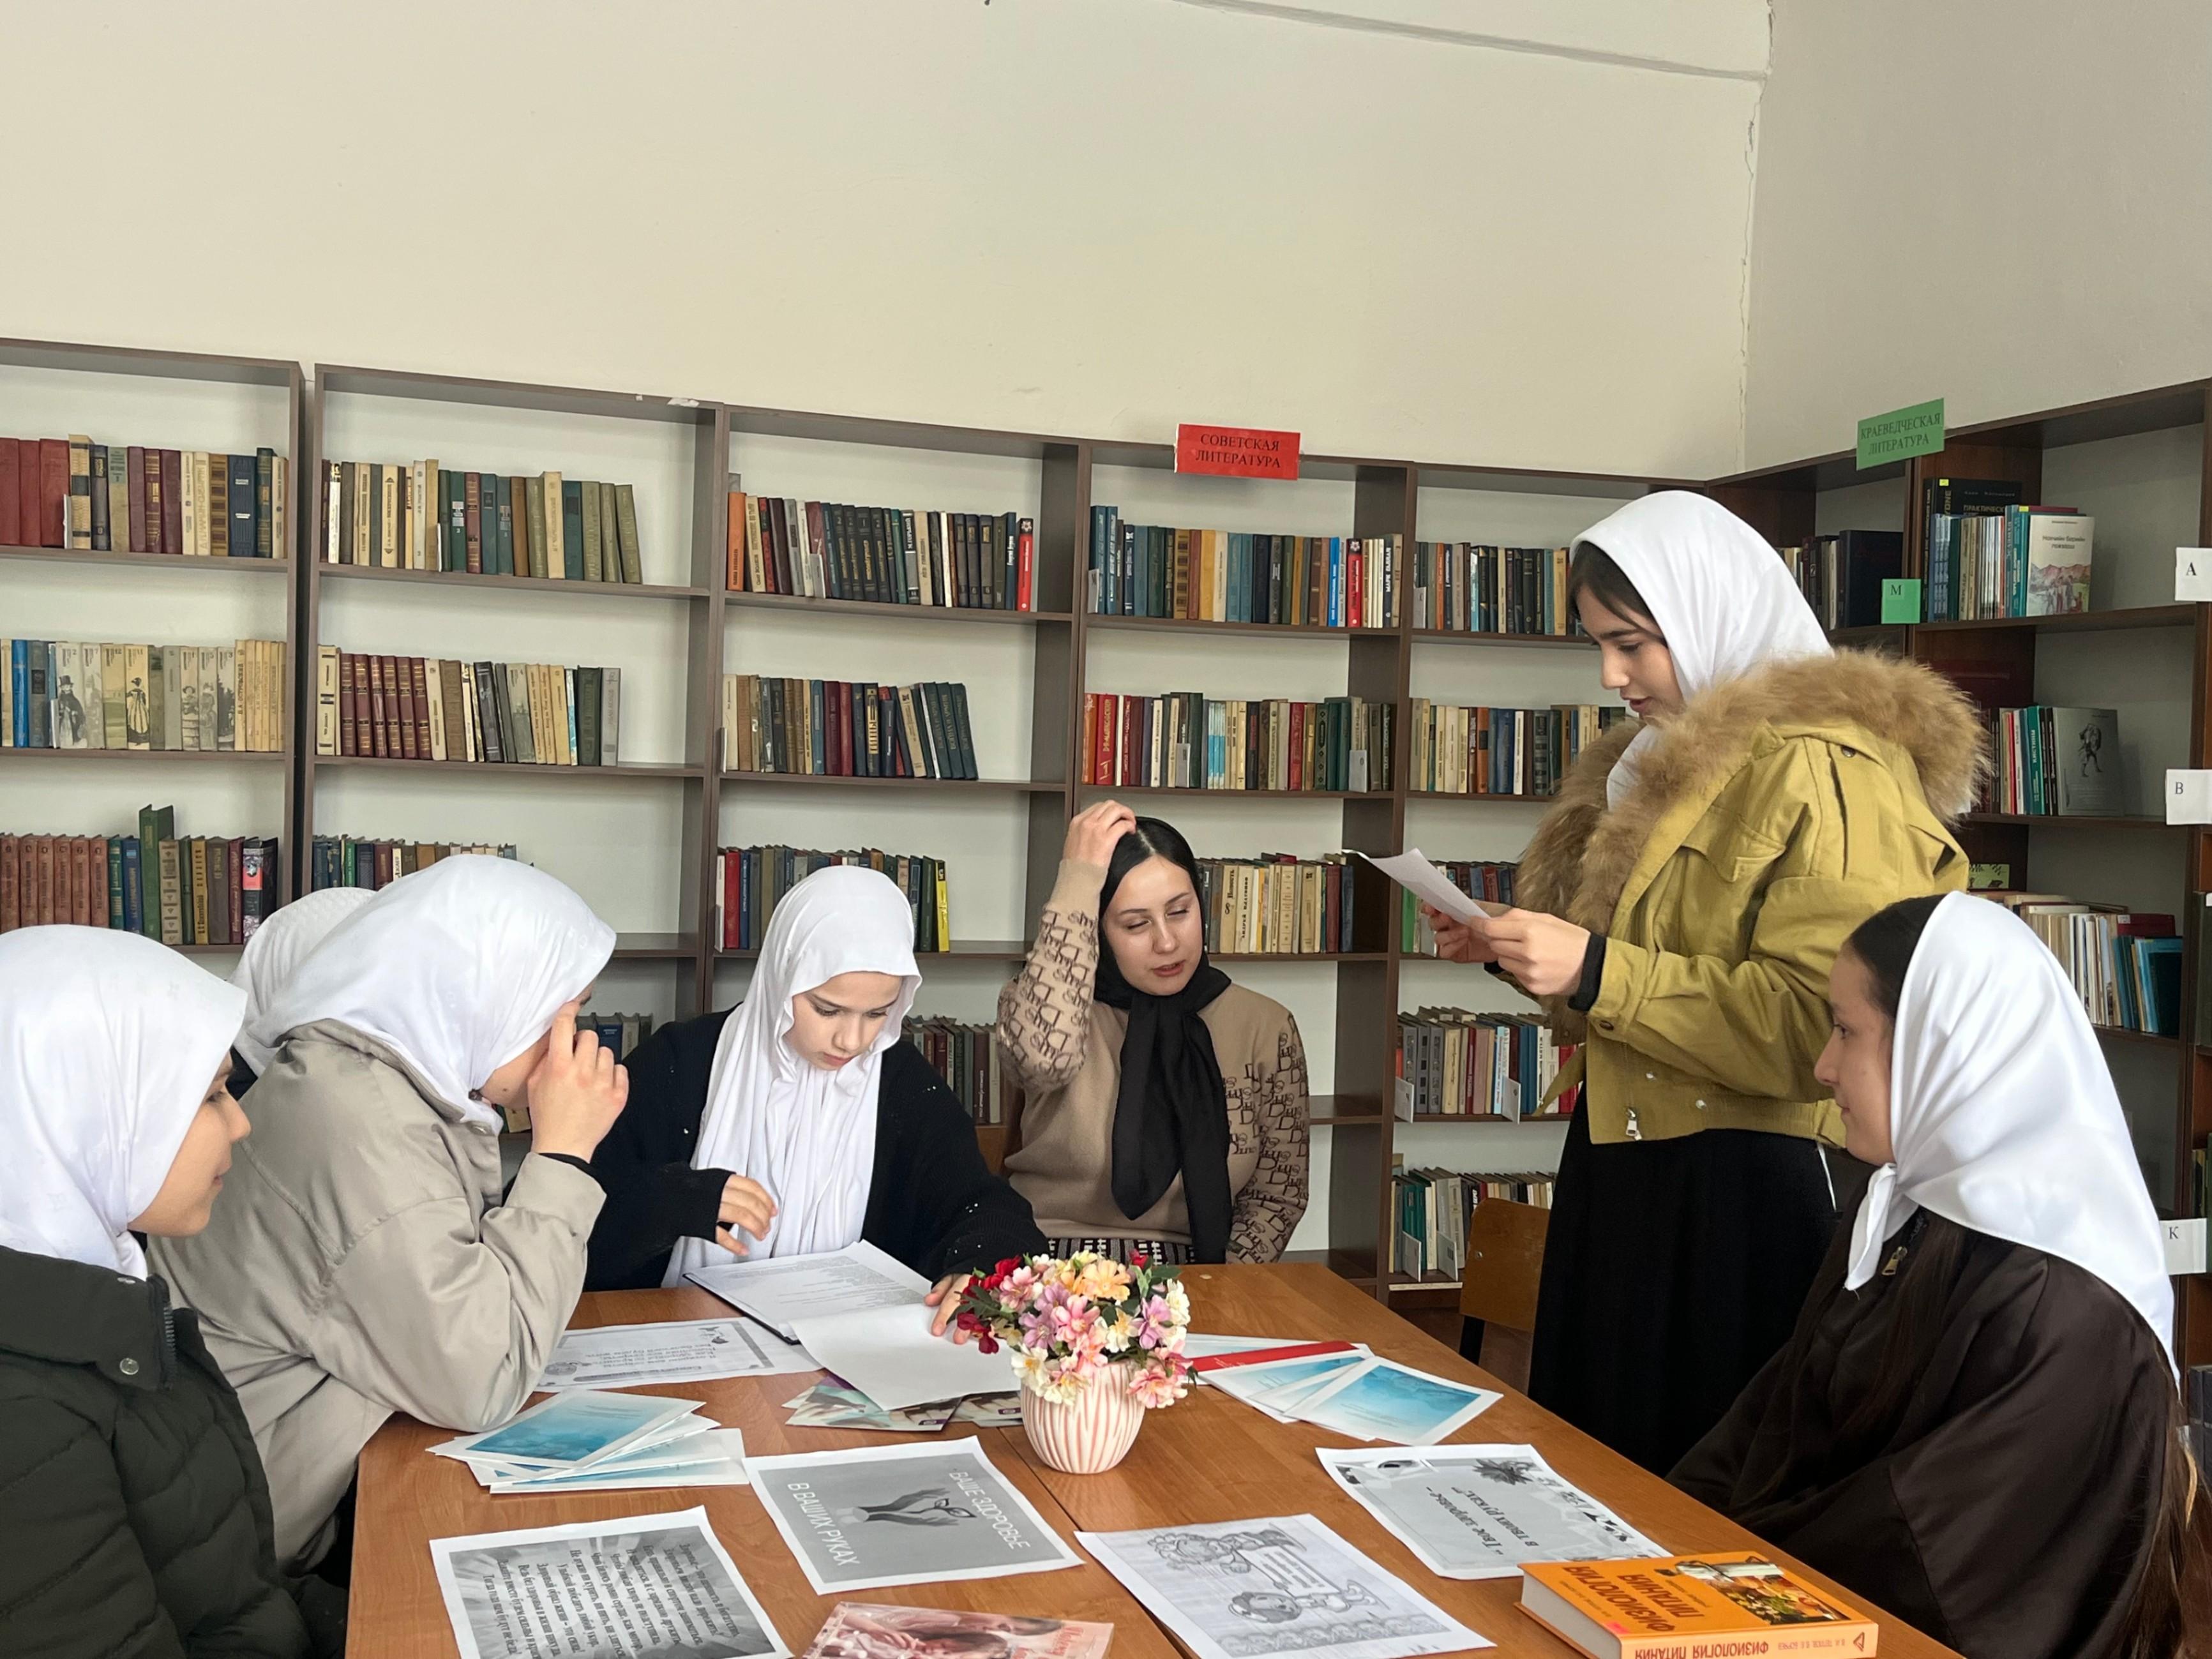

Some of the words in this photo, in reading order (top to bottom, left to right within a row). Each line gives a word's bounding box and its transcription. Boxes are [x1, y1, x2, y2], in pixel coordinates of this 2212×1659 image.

[1860, 413, 1941, 440] КРАЕВЕДЧЕСКАЯ
[1200, 433, 1279, 451] СОВЕТСКАЯ
[1868, 433, 1930, 456] ЛИТЕРАТУРА
[1195, 449, 1281, 468] ЛИТЕРАТУРА
[787, 1482, 809, 1492] В
[796, 1490, 833, 1529] ВАШИХ
[948, 1470, 987, 1499] ВАШЕ
[970, 1496, 1032, 1550] ЗДОРОВЬЕ
[822, 1529, 861, 1566] РУКАХ
[1563, 1566, 1676, 1633] ФИЗИОЛОГИЯ
[1618, 1573, 1705, 1618] ПИТАНИЯ
[1634, 1646, 1687, 1659] ПИТАНИЯ
[1692, 1640, 1770, 1657] ФИЗИОЛОГИЯ
